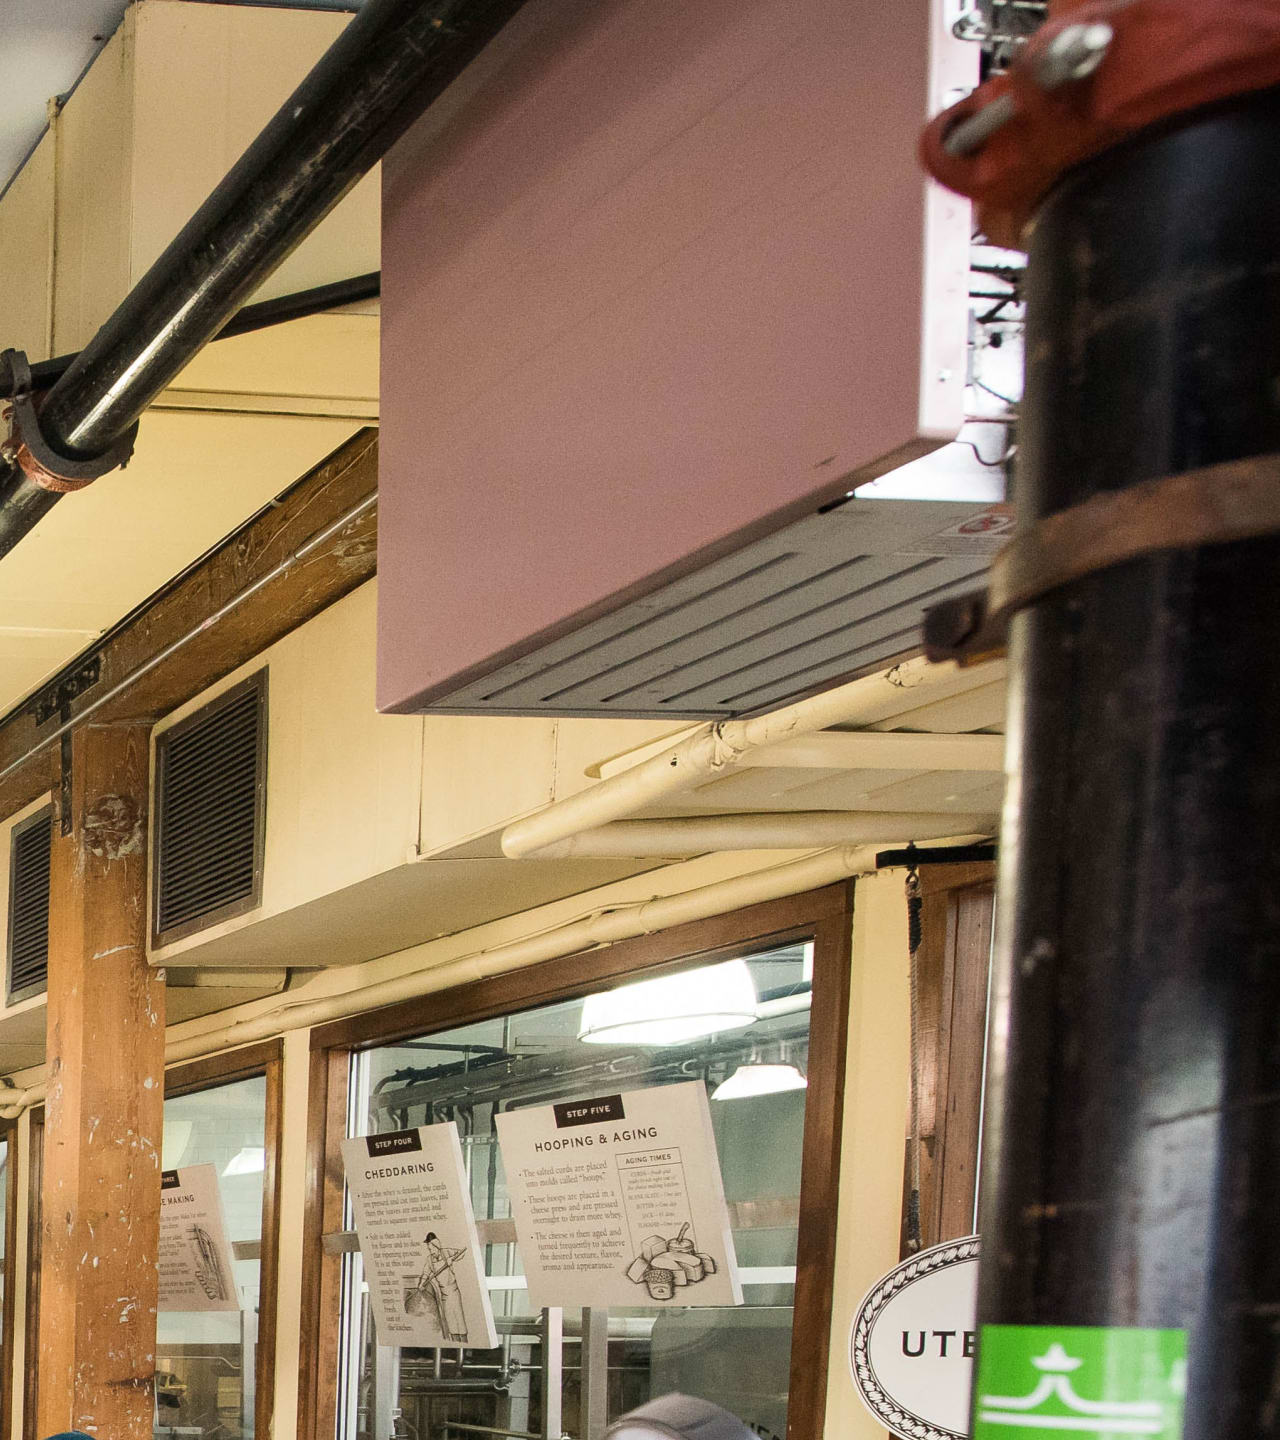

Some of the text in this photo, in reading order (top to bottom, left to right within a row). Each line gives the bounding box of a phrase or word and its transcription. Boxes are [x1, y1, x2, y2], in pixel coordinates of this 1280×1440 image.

[567, 1105, 611, 1118] STEP FIVE
[375, 1138, 412, 1149] STEP FOUR
[535, 1127, 657, 1152] HOOPING & AGING
[625, 1156, 648, 1164] AGING
[365, 1163, 434, 1179] CHEDDARING
[168, 1194, 194, 1204] MAKING
